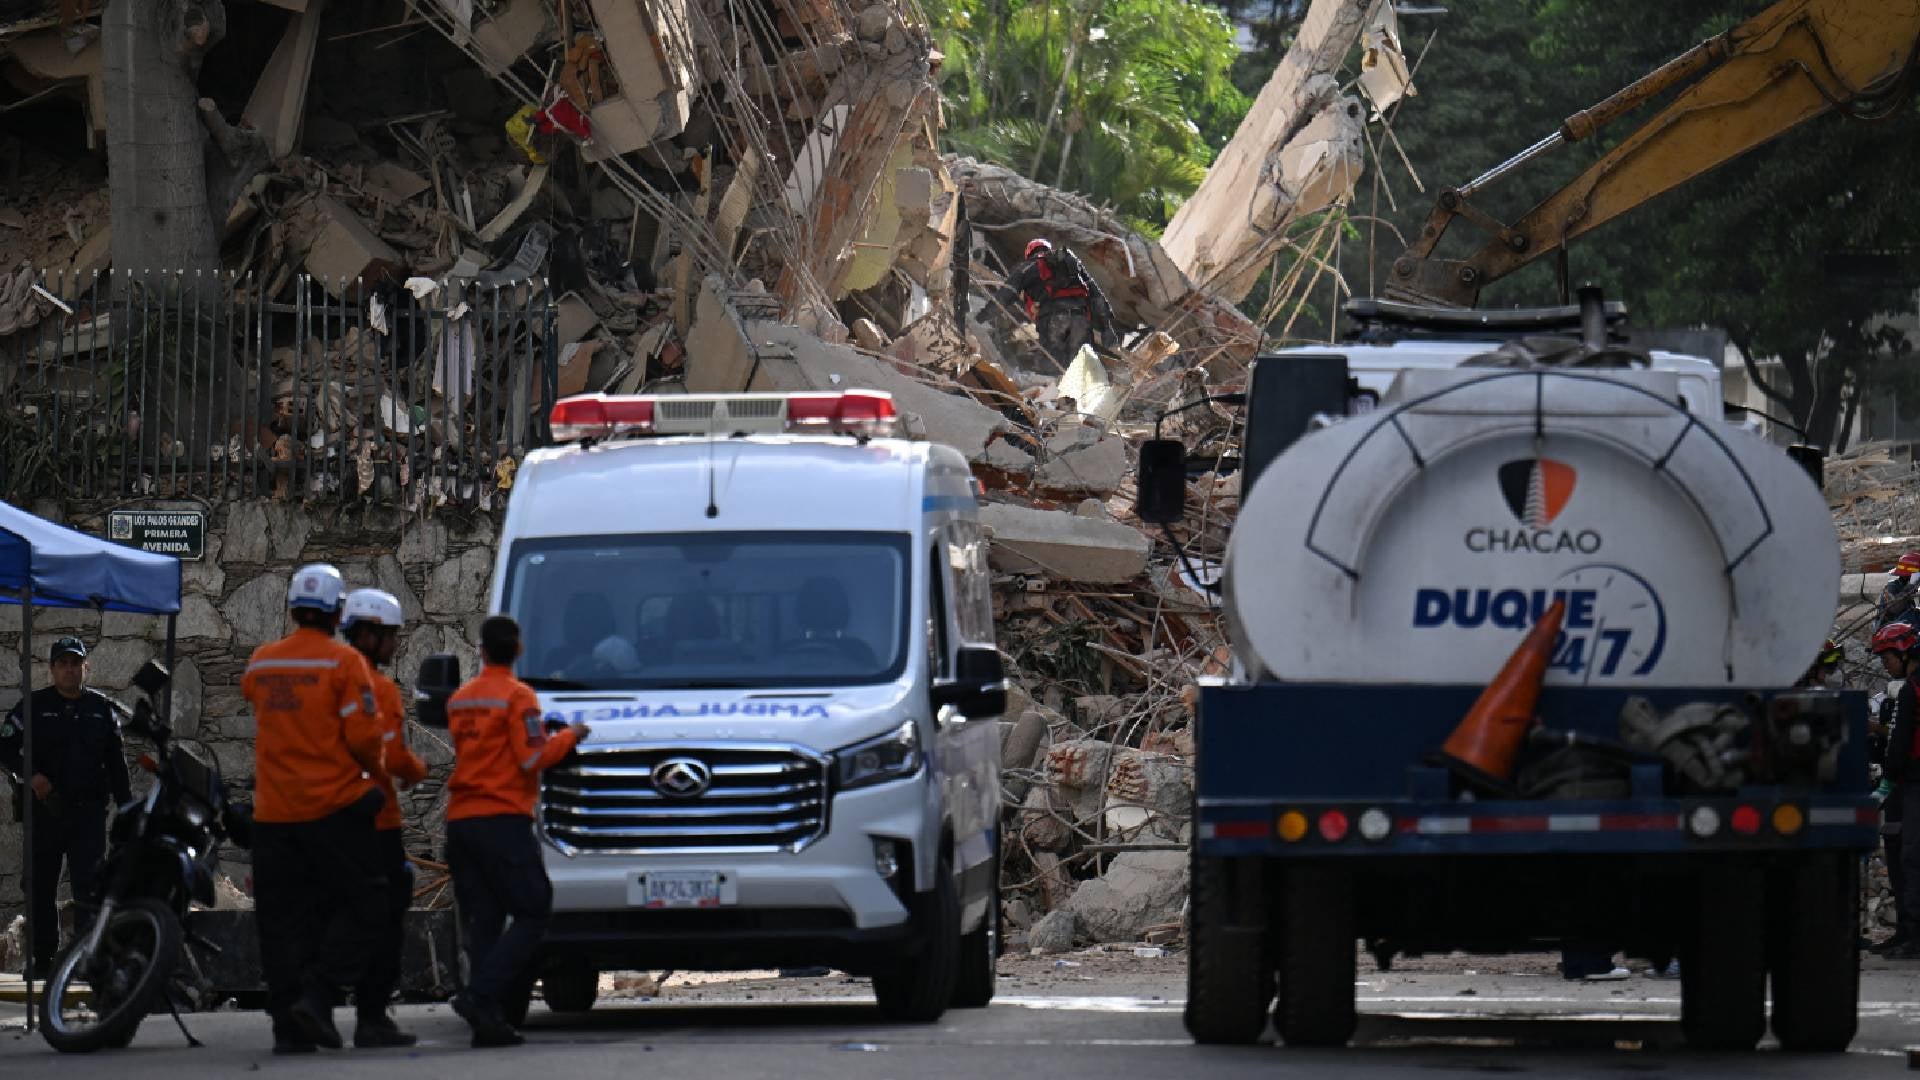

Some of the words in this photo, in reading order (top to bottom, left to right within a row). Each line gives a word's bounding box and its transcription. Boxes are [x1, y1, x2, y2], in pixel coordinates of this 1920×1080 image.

[134, 515, 146, 526] LOS
[144, 529, 188, 538] PRIMERA
[1465, 527, 1602, 554] CHACAO
[142, 542, 190, 552] AVENIDA
[1413, 588, 1597, 631] DUQUE
